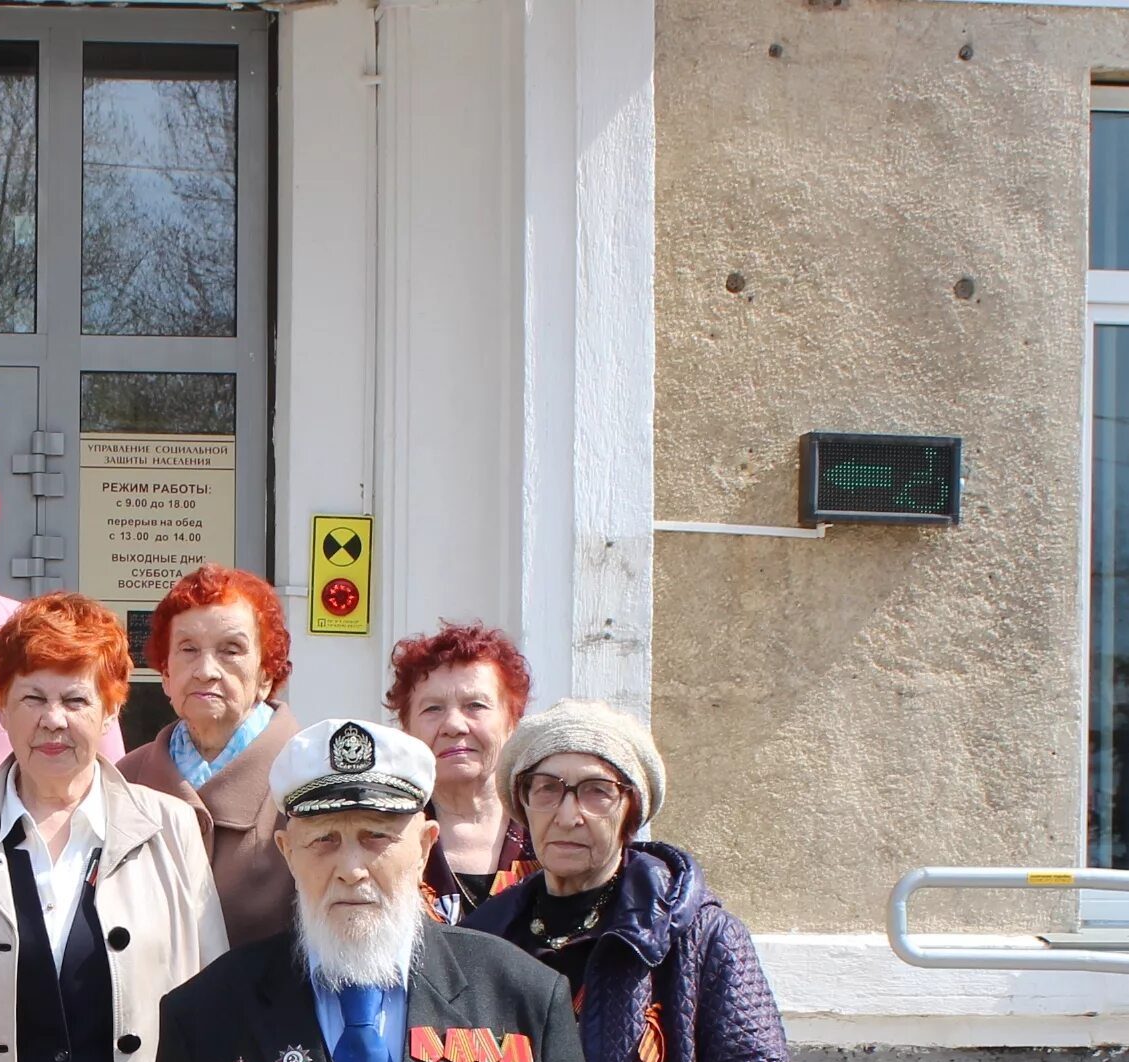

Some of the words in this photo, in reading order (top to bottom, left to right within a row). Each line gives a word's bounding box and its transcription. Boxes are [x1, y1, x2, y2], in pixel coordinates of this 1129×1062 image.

[88, 444, 150, 453] УПРАВЛЕНИЕ
[155, 444, 228, 455] СОЦИАЛЬНОЙ
[104, 456, 148, 465] ЗАЩИТЫ
[152, 457, 211, 466] НАСЕЛЕНИЯ
[102, 482, 149, 493] РЕЖИМ
[153, 484, 212, 495] РАБОТЫ:
[125, 499, 148, 508] 9.00
[150, 501, 165, 509] до
[169, 500, 196, 509] 18.00
[107, 519, 158, 528] перерыв
[160, 519, 173, 527] на
[175, 517, 203, 528] обед
[109, 533, 115, 541] с
[121, 532, 149, 541] 13.00
[155, 533, 169, 542] до
[174, 533, 202, 542] 14.00
[111, 553, 177, 565] ВЫХОДНЫЕ
[131, 568, 183, 579] СУББОТА
[118, 580, 176, 590] ВОСКРЕСЕ
